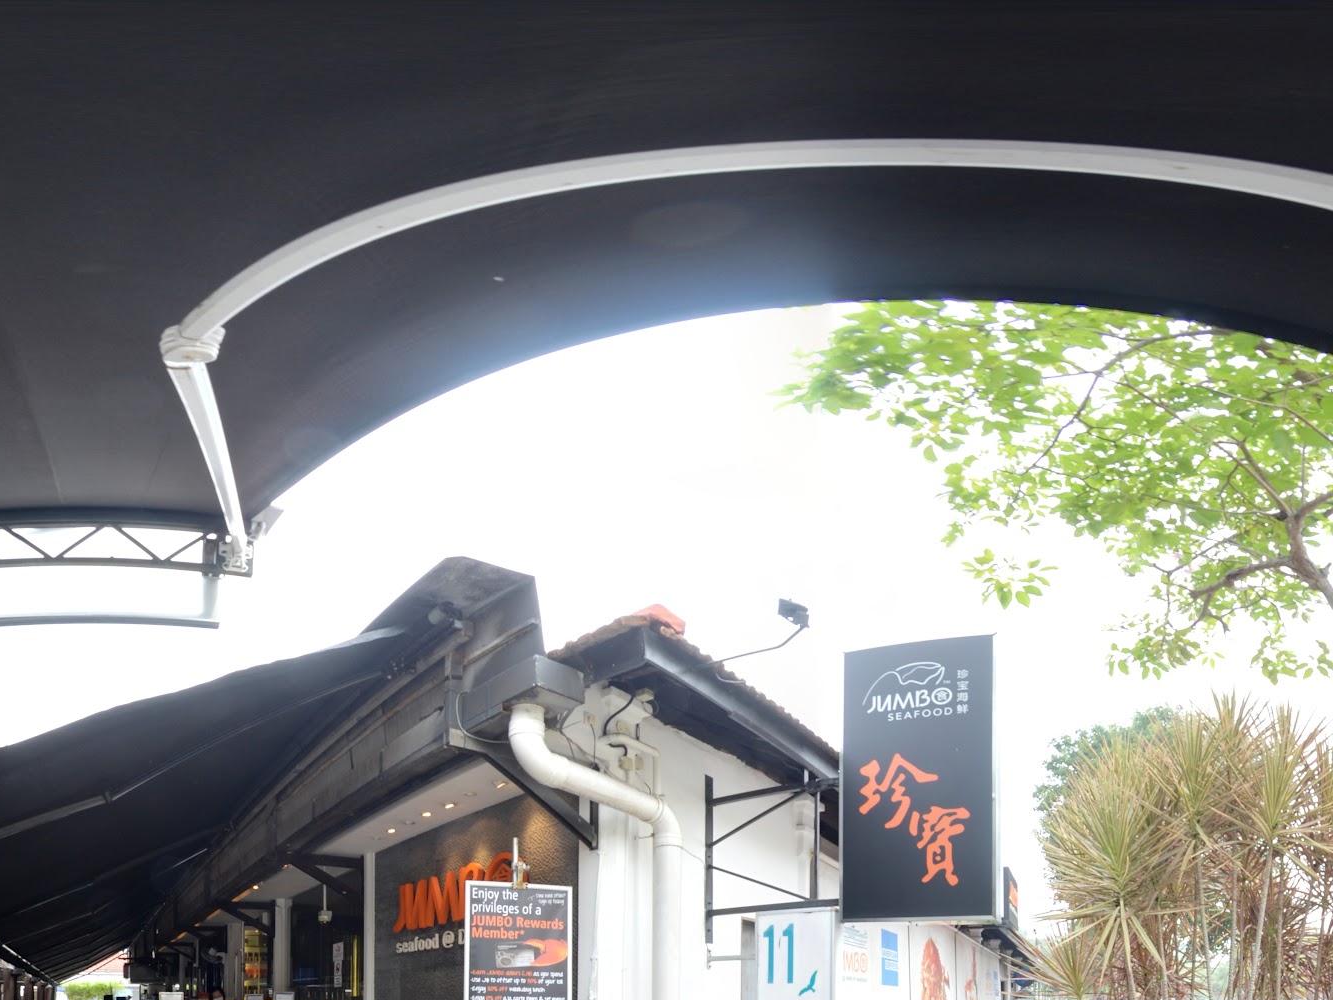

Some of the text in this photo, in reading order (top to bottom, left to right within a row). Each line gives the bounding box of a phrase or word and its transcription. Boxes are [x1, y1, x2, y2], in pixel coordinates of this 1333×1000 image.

[867, 687, 952, 714] JUMBO
[888, 707, 953, 722] SEAFOOD
[472, 887, 518, 902] Enjoy the
[472, 902, 542, 916] privileges of a
[472, 915, 564, 930] JUMBO Rewards
[396, 933, 439, 954] seafood
[442, 930, 456, 946] @
[763, 924, 794, 984] 11
